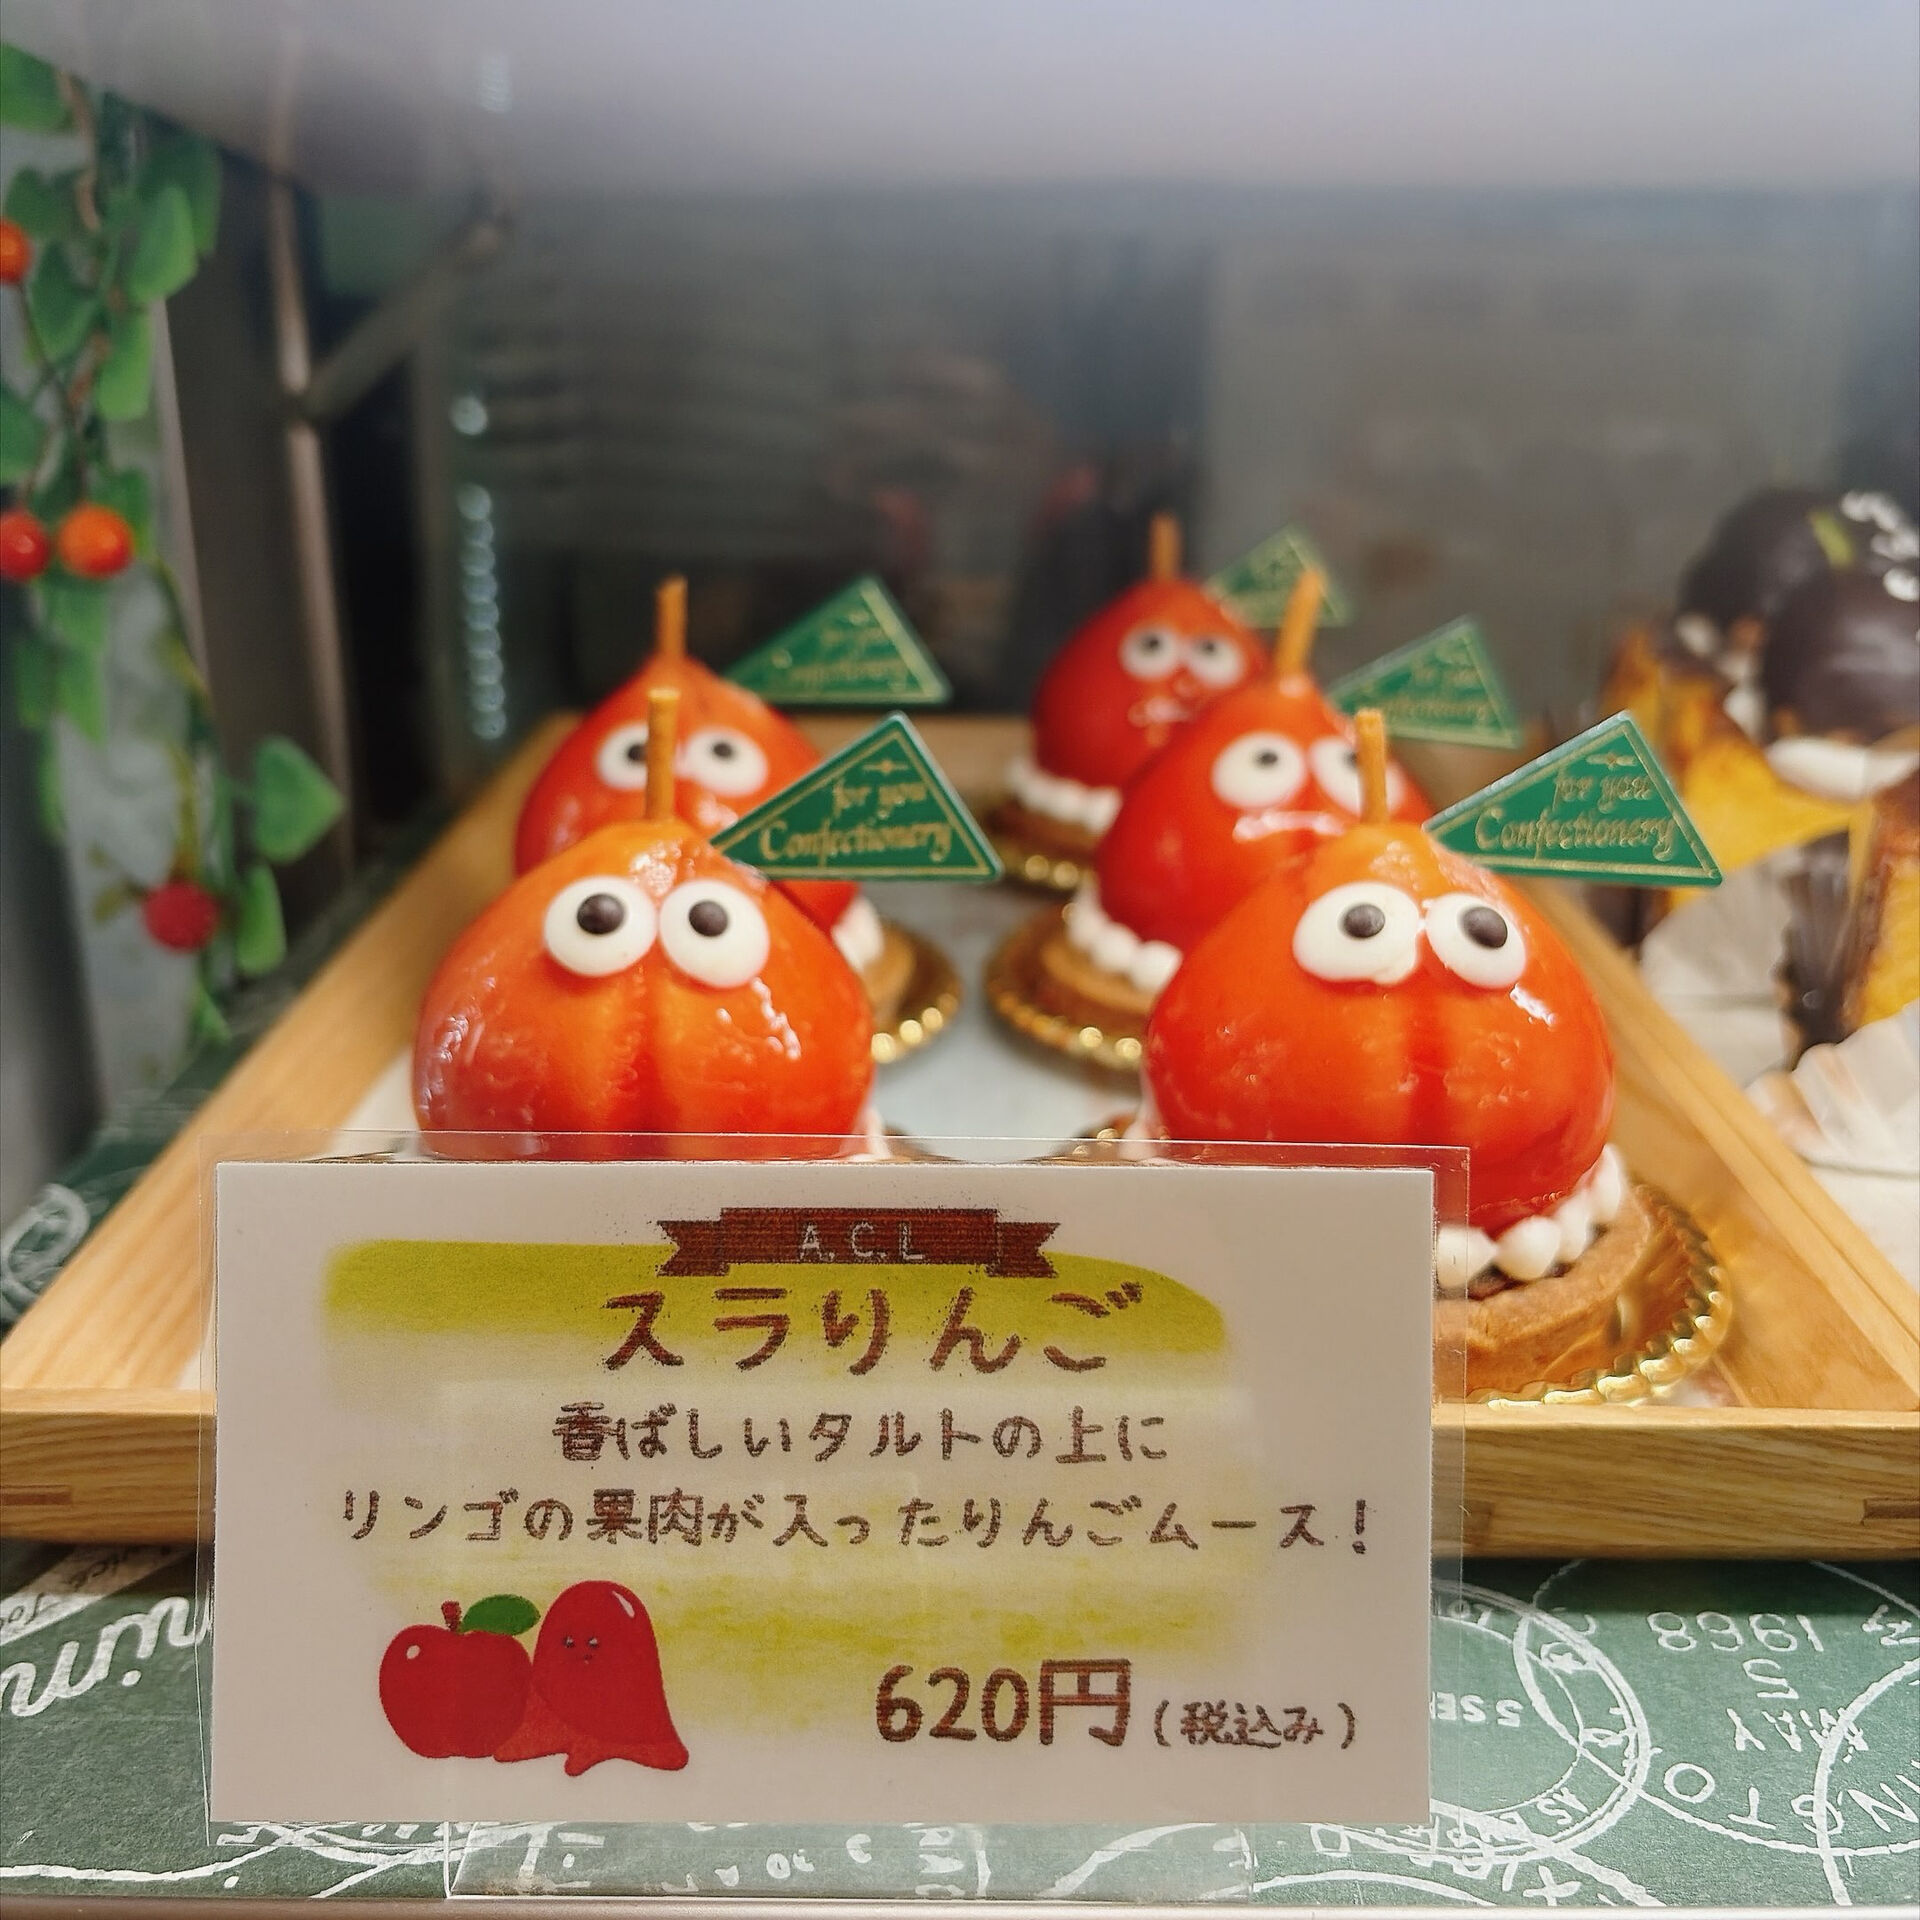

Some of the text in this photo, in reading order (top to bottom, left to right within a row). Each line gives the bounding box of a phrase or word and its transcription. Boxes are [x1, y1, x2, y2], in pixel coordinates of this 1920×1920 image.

[759, 816, 950, 868] Confectionery
[1475, 804, 1675, 862] Confectionery
[602, 1281, 1144, 1375] スラりんご
[552, 1400, 1168, 1464] 香ばしいタルトの上に
[342, 1486, 1371, 1554] リンゴの果肉が入ったりんごムース！
[1647, 1611, 1825, 1652] 1968
[875, 1657, 1356, 1750] 620円 (税込み)
